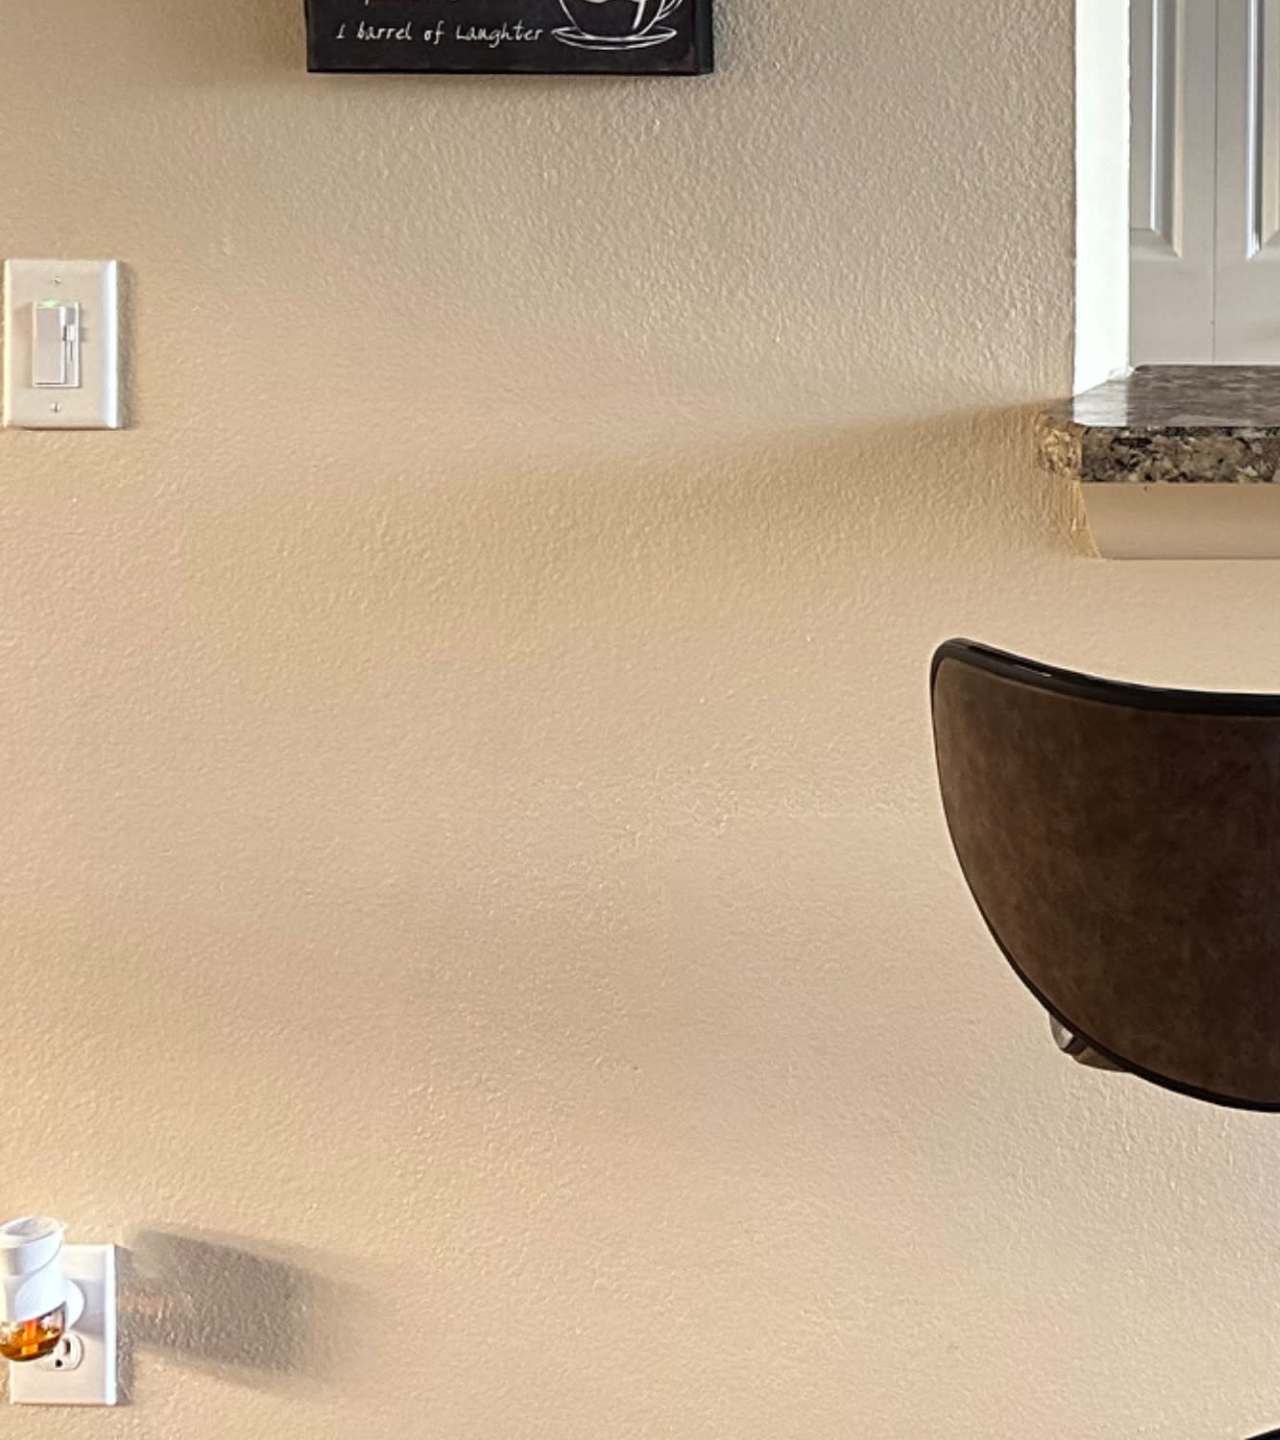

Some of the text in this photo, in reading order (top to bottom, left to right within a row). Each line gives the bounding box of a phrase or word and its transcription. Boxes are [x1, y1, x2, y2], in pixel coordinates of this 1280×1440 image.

[336, 21, 543, 47] 1 barrel of Laughter
